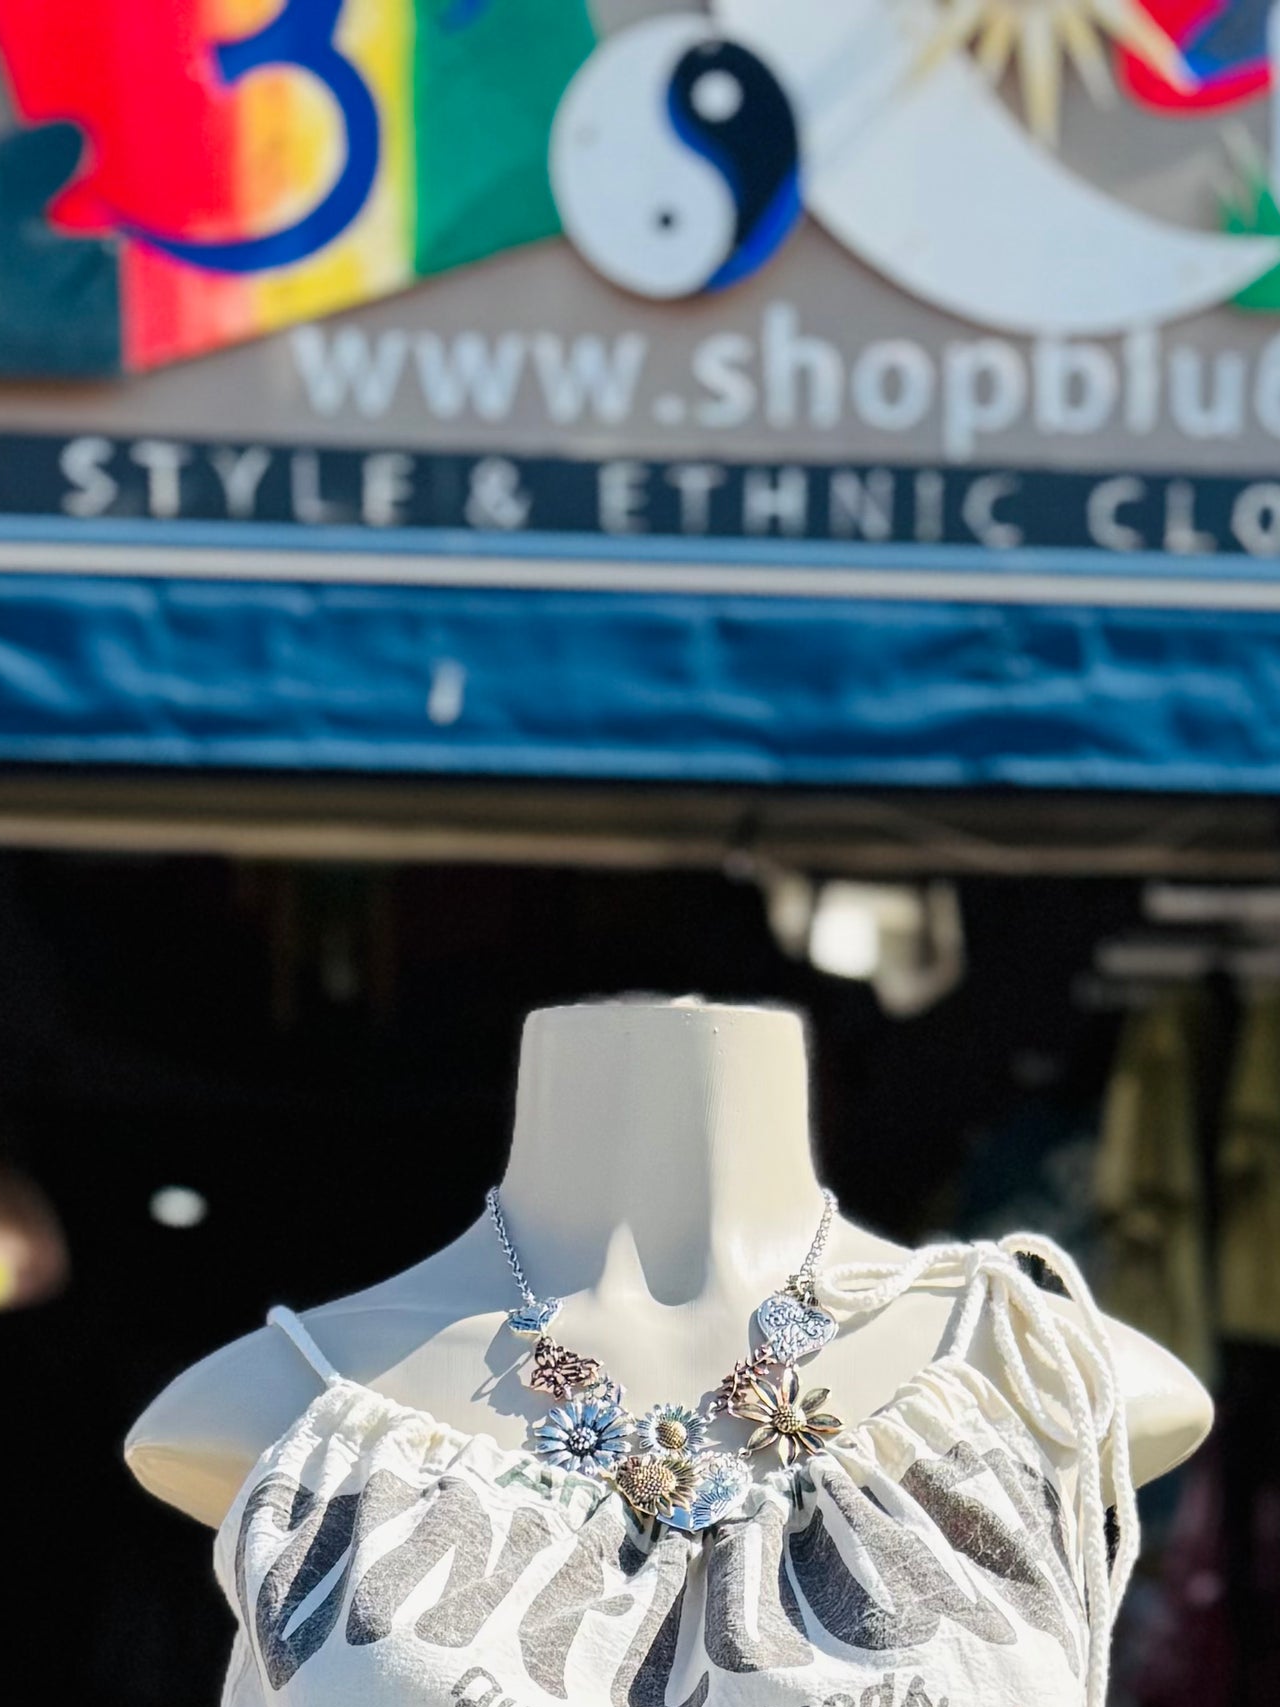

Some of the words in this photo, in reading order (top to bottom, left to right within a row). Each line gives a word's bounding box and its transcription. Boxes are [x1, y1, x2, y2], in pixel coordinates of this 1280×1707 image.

[60, 438, 416, 526] STYLE
[464, 455, 532, 536] &
[600, 462, 1020, 546] ETHNIC
